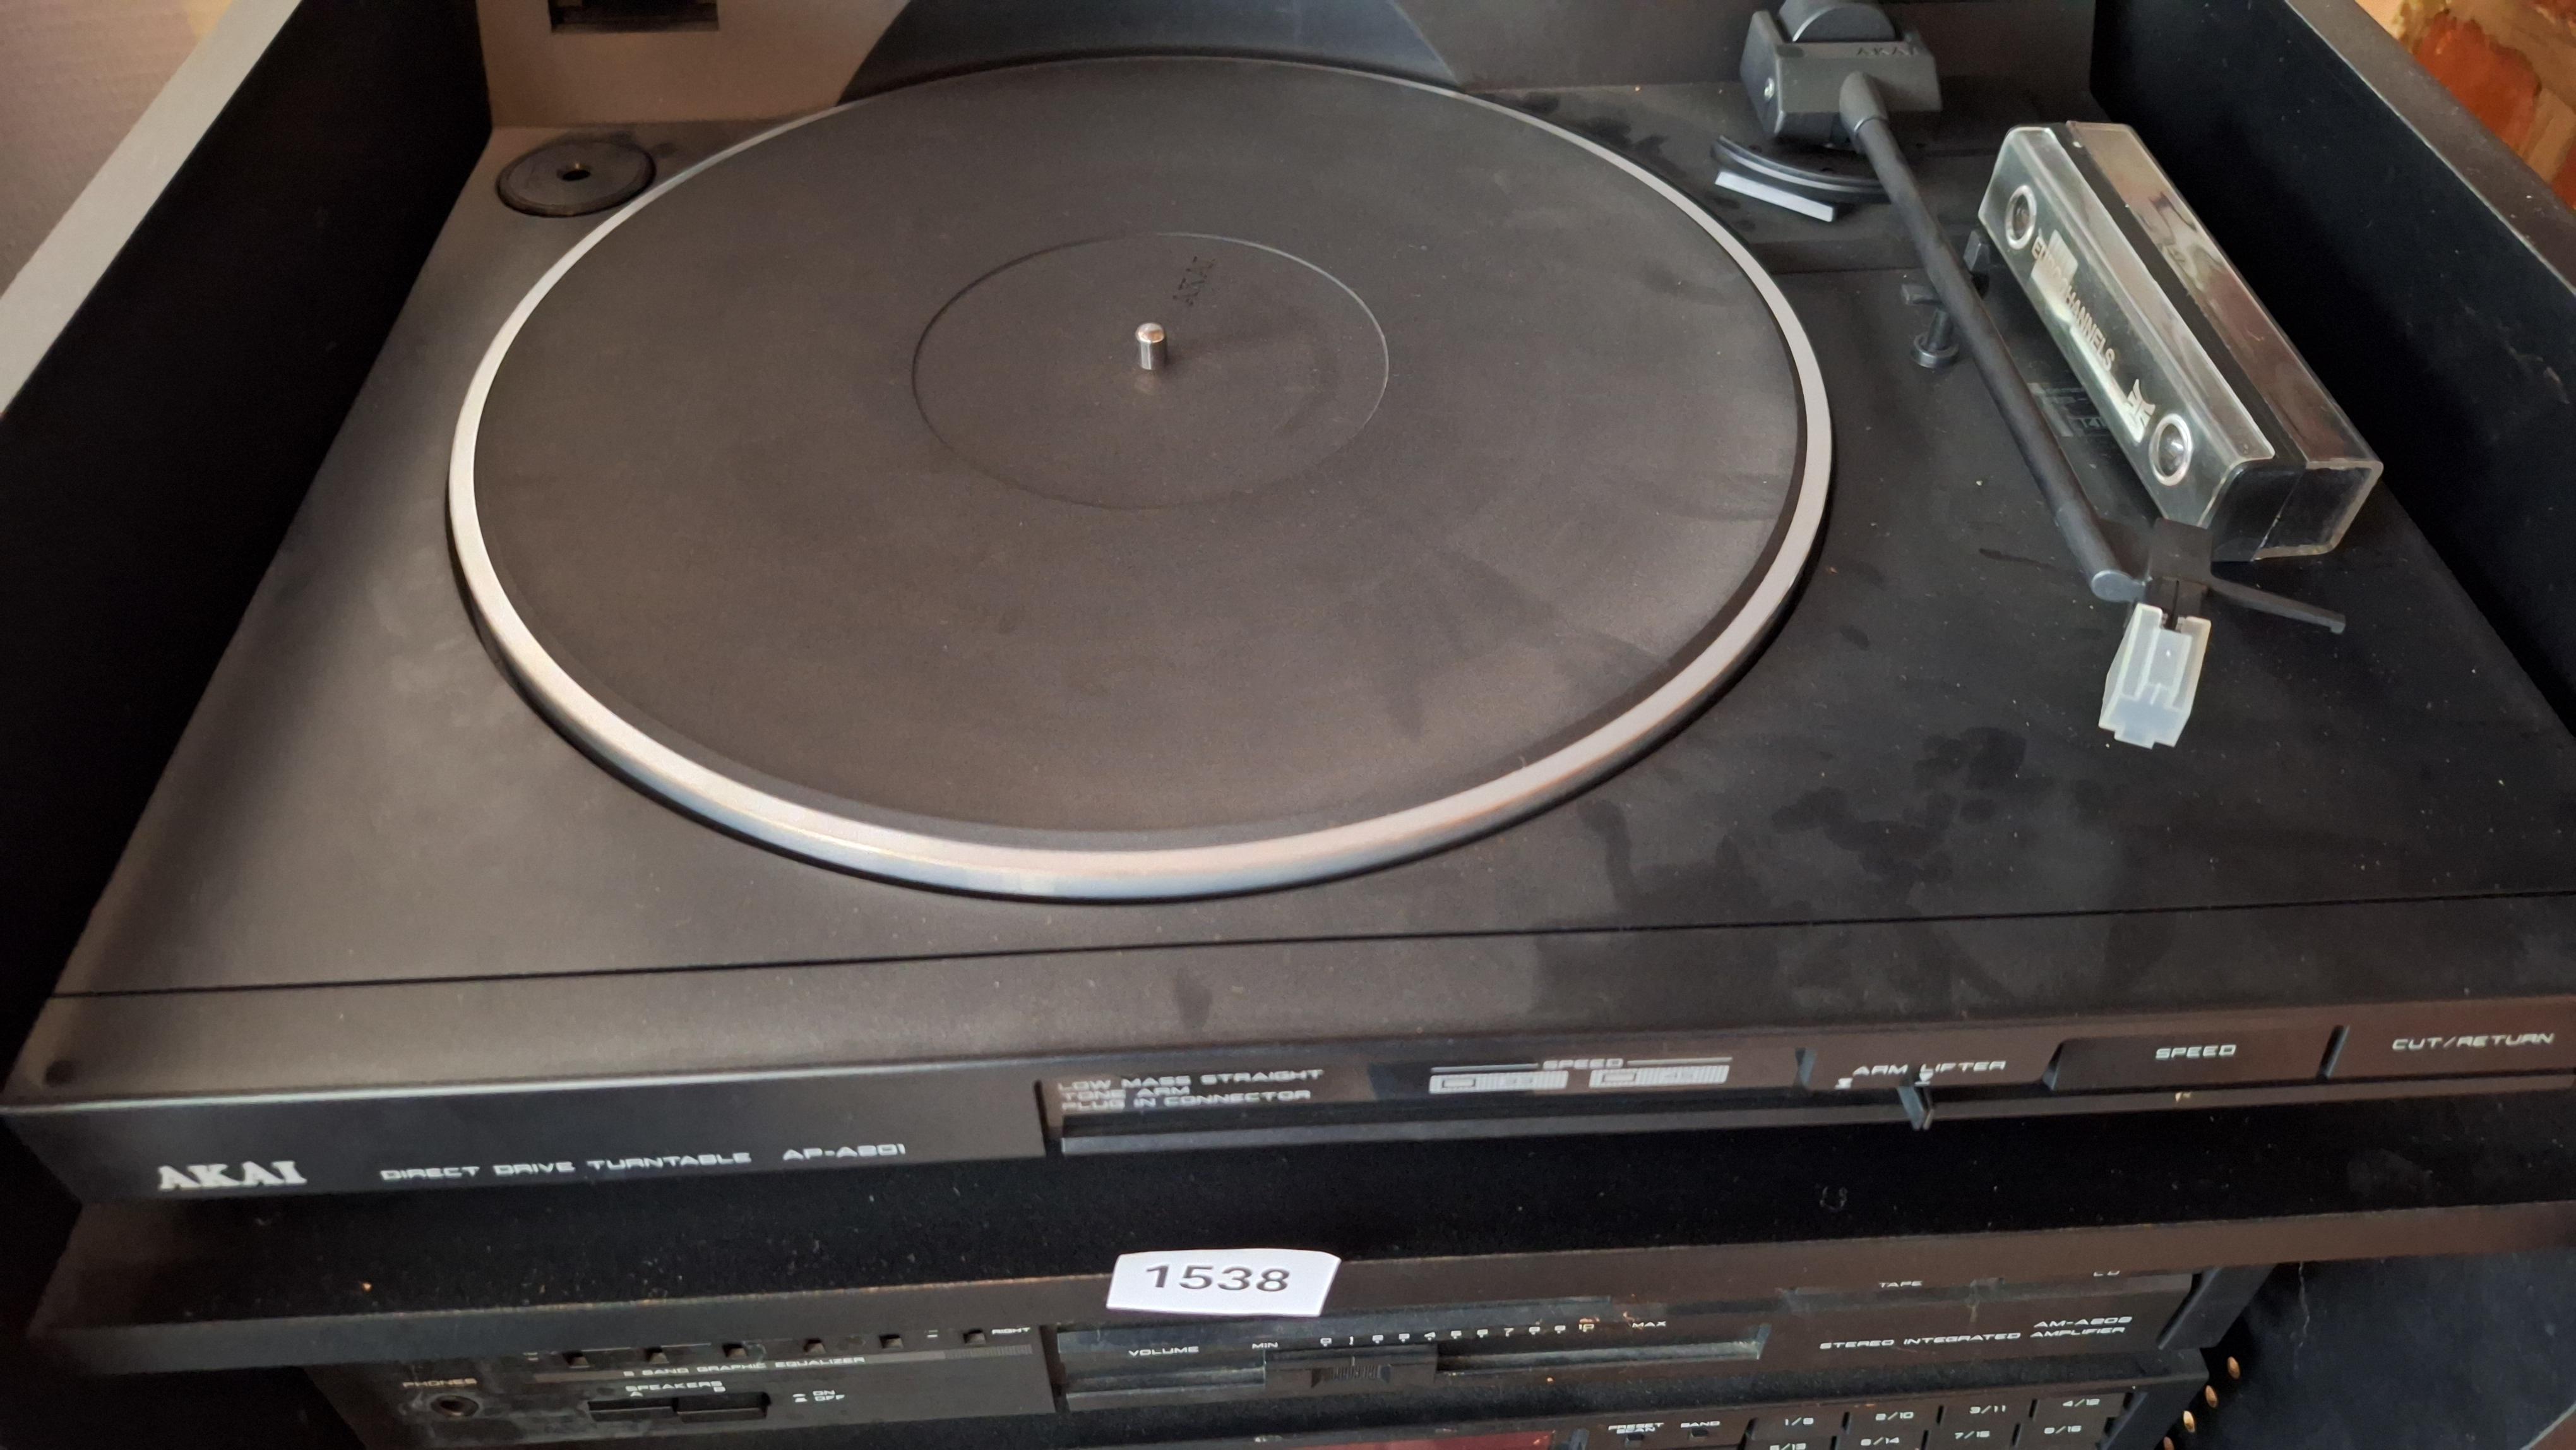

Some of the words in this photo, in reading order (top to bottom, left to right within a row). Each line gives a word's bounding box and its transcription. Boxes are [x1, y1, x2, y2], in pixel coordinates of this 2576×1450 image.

[2392, 1033, 2554, 1050] CUT/RETURN
[2155, 1044, 2236, 1059] SPEED
[1542, 1058, 1624, 1070] SPEED
[1851, 1064, 1909, 1077] ARM
[1919, 1060, 2007, 1076] LIFTER
[1058, 1079, 1111, 1093] LOW
[1121, 1076, 1191, 1088] MASS
[1200, 1069, 1324, 1086] STRAIGHT
[1061, 1099, 1126, 1111] PLUG
[1133, 1096, 1157, 1109] IN
[1163, 1089, 1313, 1106] CONNECTOR
[1063, 1089, 1127, 1101] TONE
[1136, 1086, 1191, 1098] ARM
[380, 1166, 480, 1180] DIRECT
[492, 1161, 575, 1176] DRIVE
[587, 1152, 752, 1170] TURNTABLE
[158, 1161, 307, 1190] AKAI
[1147, 1264, 1290, 1291] 1538
[1631, 1320, 1667, 1328] MAX
[1819, 1339, 1894, 1350] STEREO
[1903, 1333, 2021, 1346] INTEGRATED
[2029, 1327, 2125, 1339] AMPLIFIER
[1128, 1346, 1199, 1357] VOLUME
[642, 1367, 689, 1376] BAND
[696, 1362, 766, 1373] GRAPHIC
[774, 1356, 866, 1369] EQUALIZER
[402, 1377, 477, 1388] PHONES
[625, 1381, 722, 1392] SPEAKERS
[814, 1394, 845, 1402] OFF
